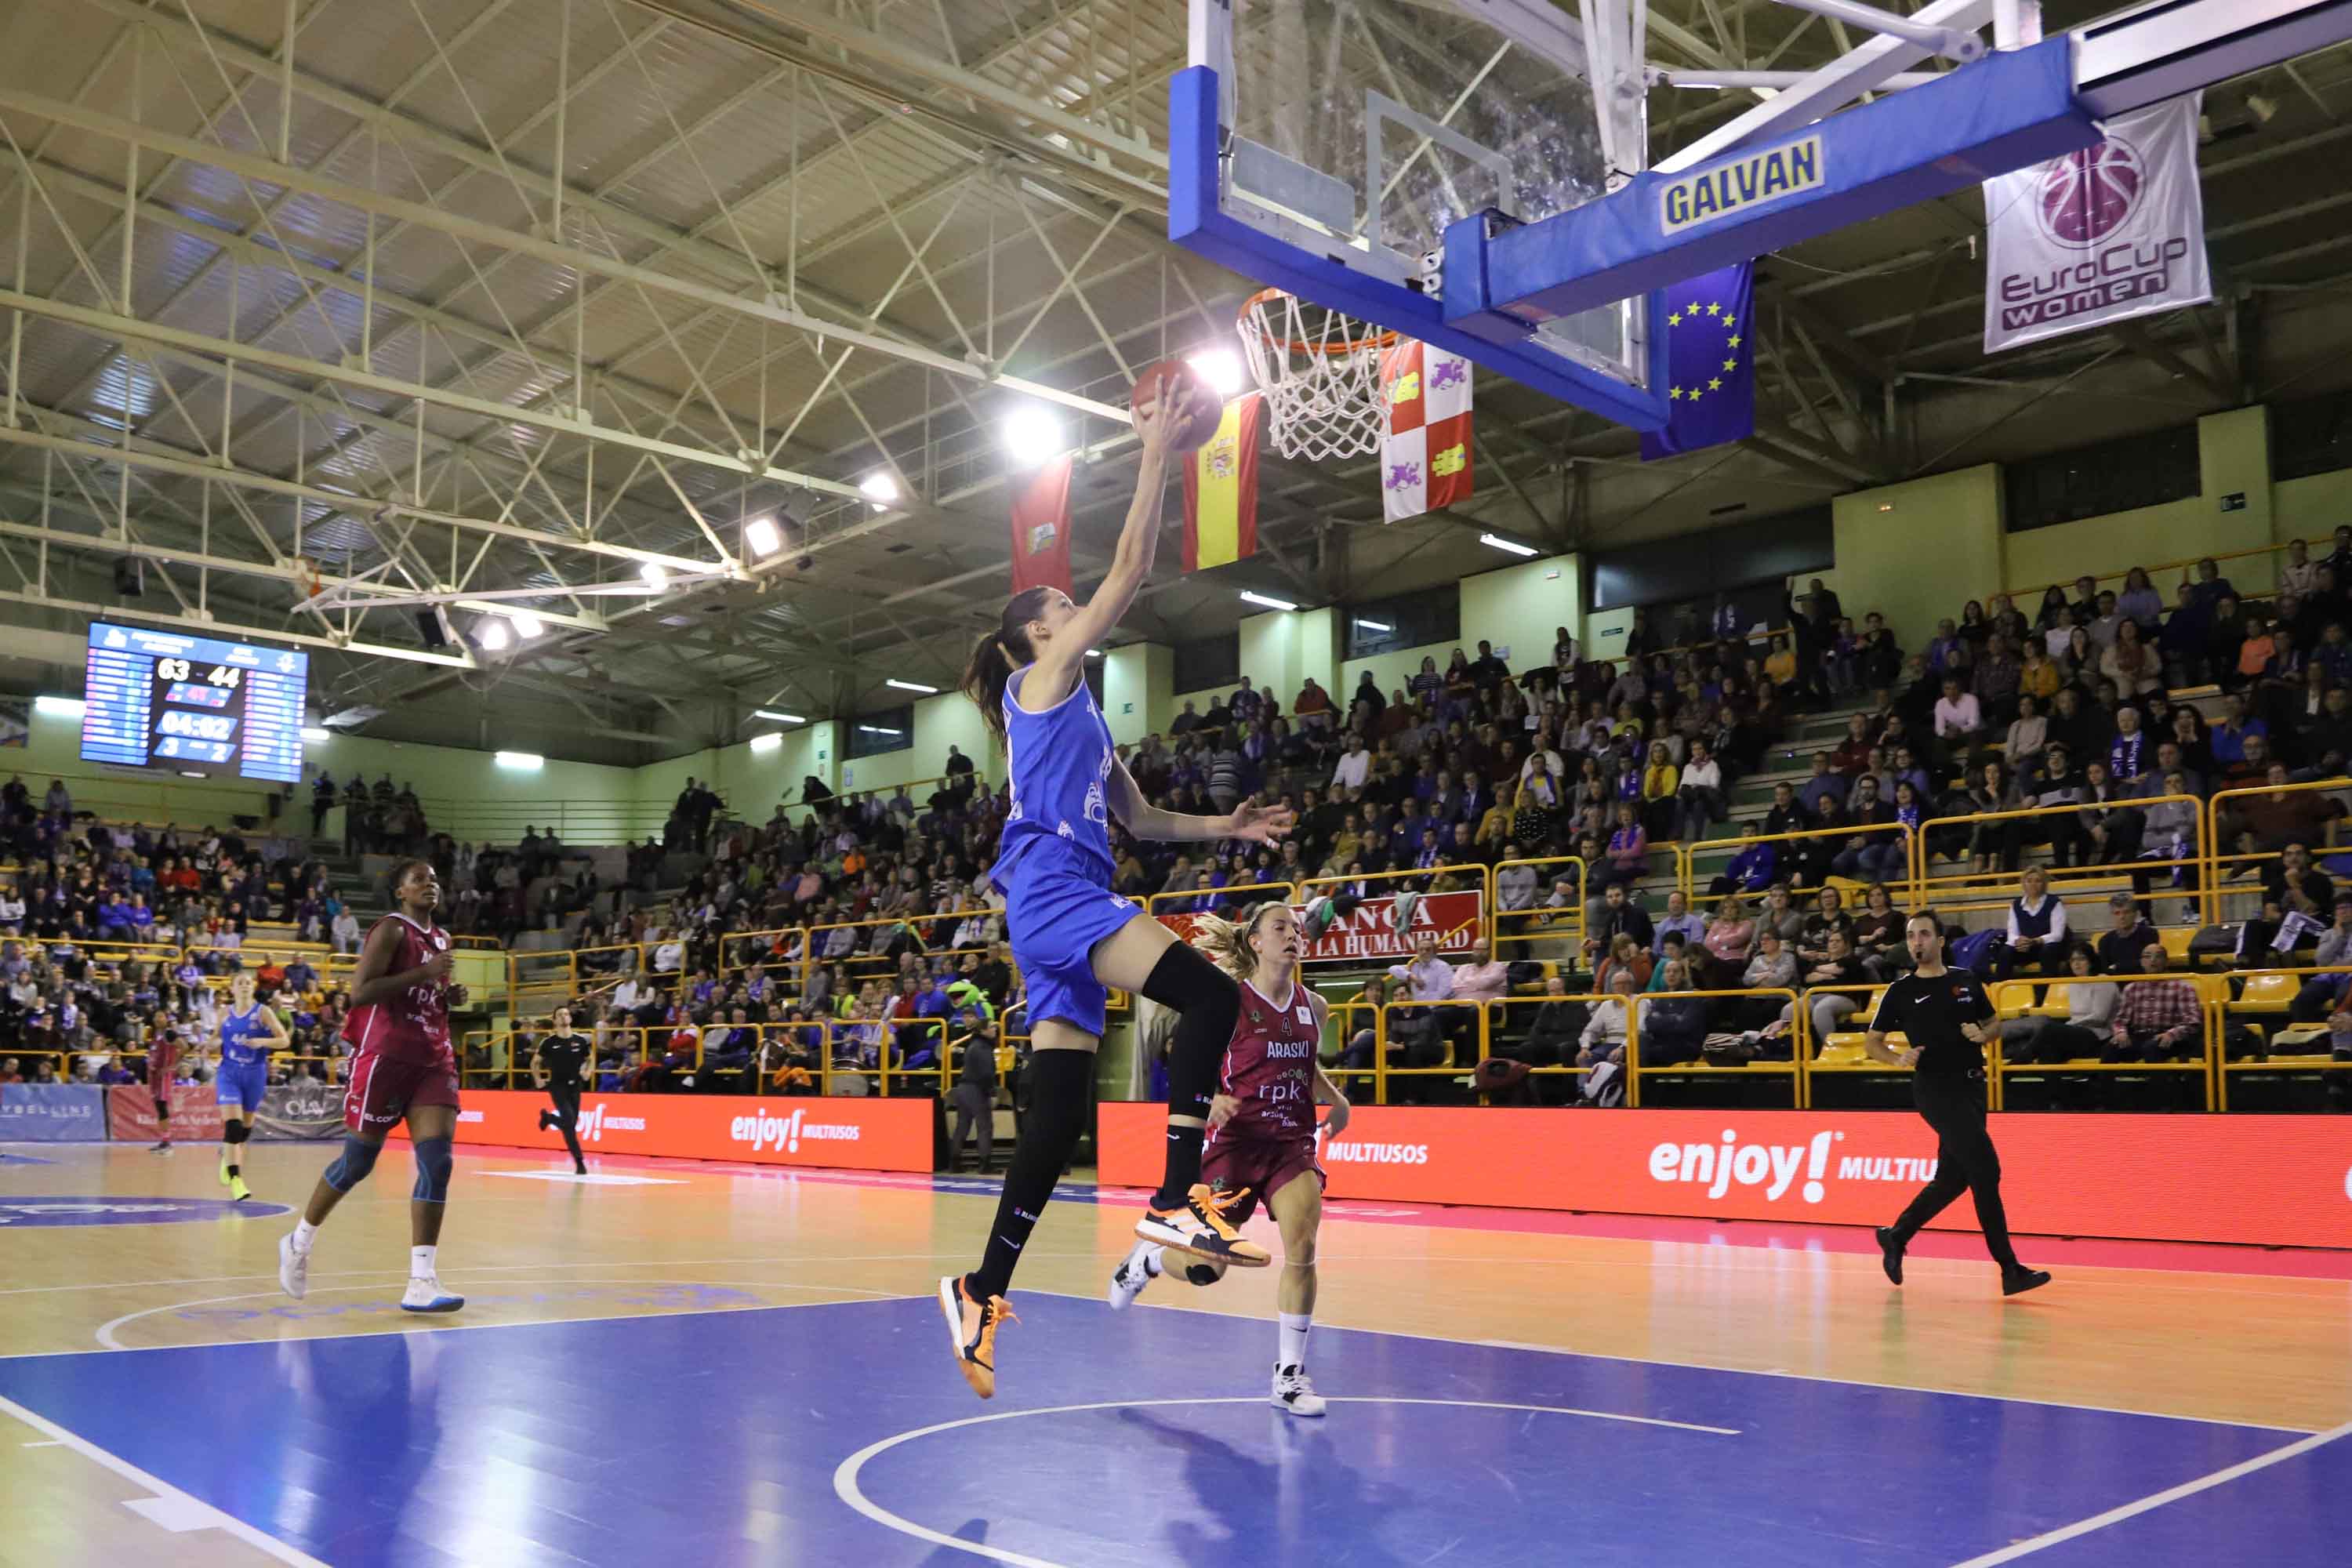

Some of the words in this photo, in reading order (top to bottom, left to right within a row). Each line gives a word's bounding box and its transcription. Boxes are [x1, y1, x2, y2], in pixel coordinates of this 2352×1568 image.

[1666, 141, 1815, 224] GALVAN
[158, 658, 191, 681] 63
[208, 666, 240, 688] 44
[162, 712, 230, 741] 04:02
[163, 738, 179, 756] 3
[212, 743, 227, 762] 2
[1317, 938, 1338, 956] LA
[1280, 1017, 1292, 1036] 4
[1267, 1040, 1308, 1058] ARASKI
[1259, 1080, 1301, 1104] rpk
[731, 1108, 801, 1153] enjoy!
[801, 1123, 860, 1140] MULTIUSOS
[1326, 1142, 1428, 1164] MULTIUSOS
[1649, 1128, 1832, 1203] enjoy!
[1838, 1156, 1939, 1182] MULTIU
